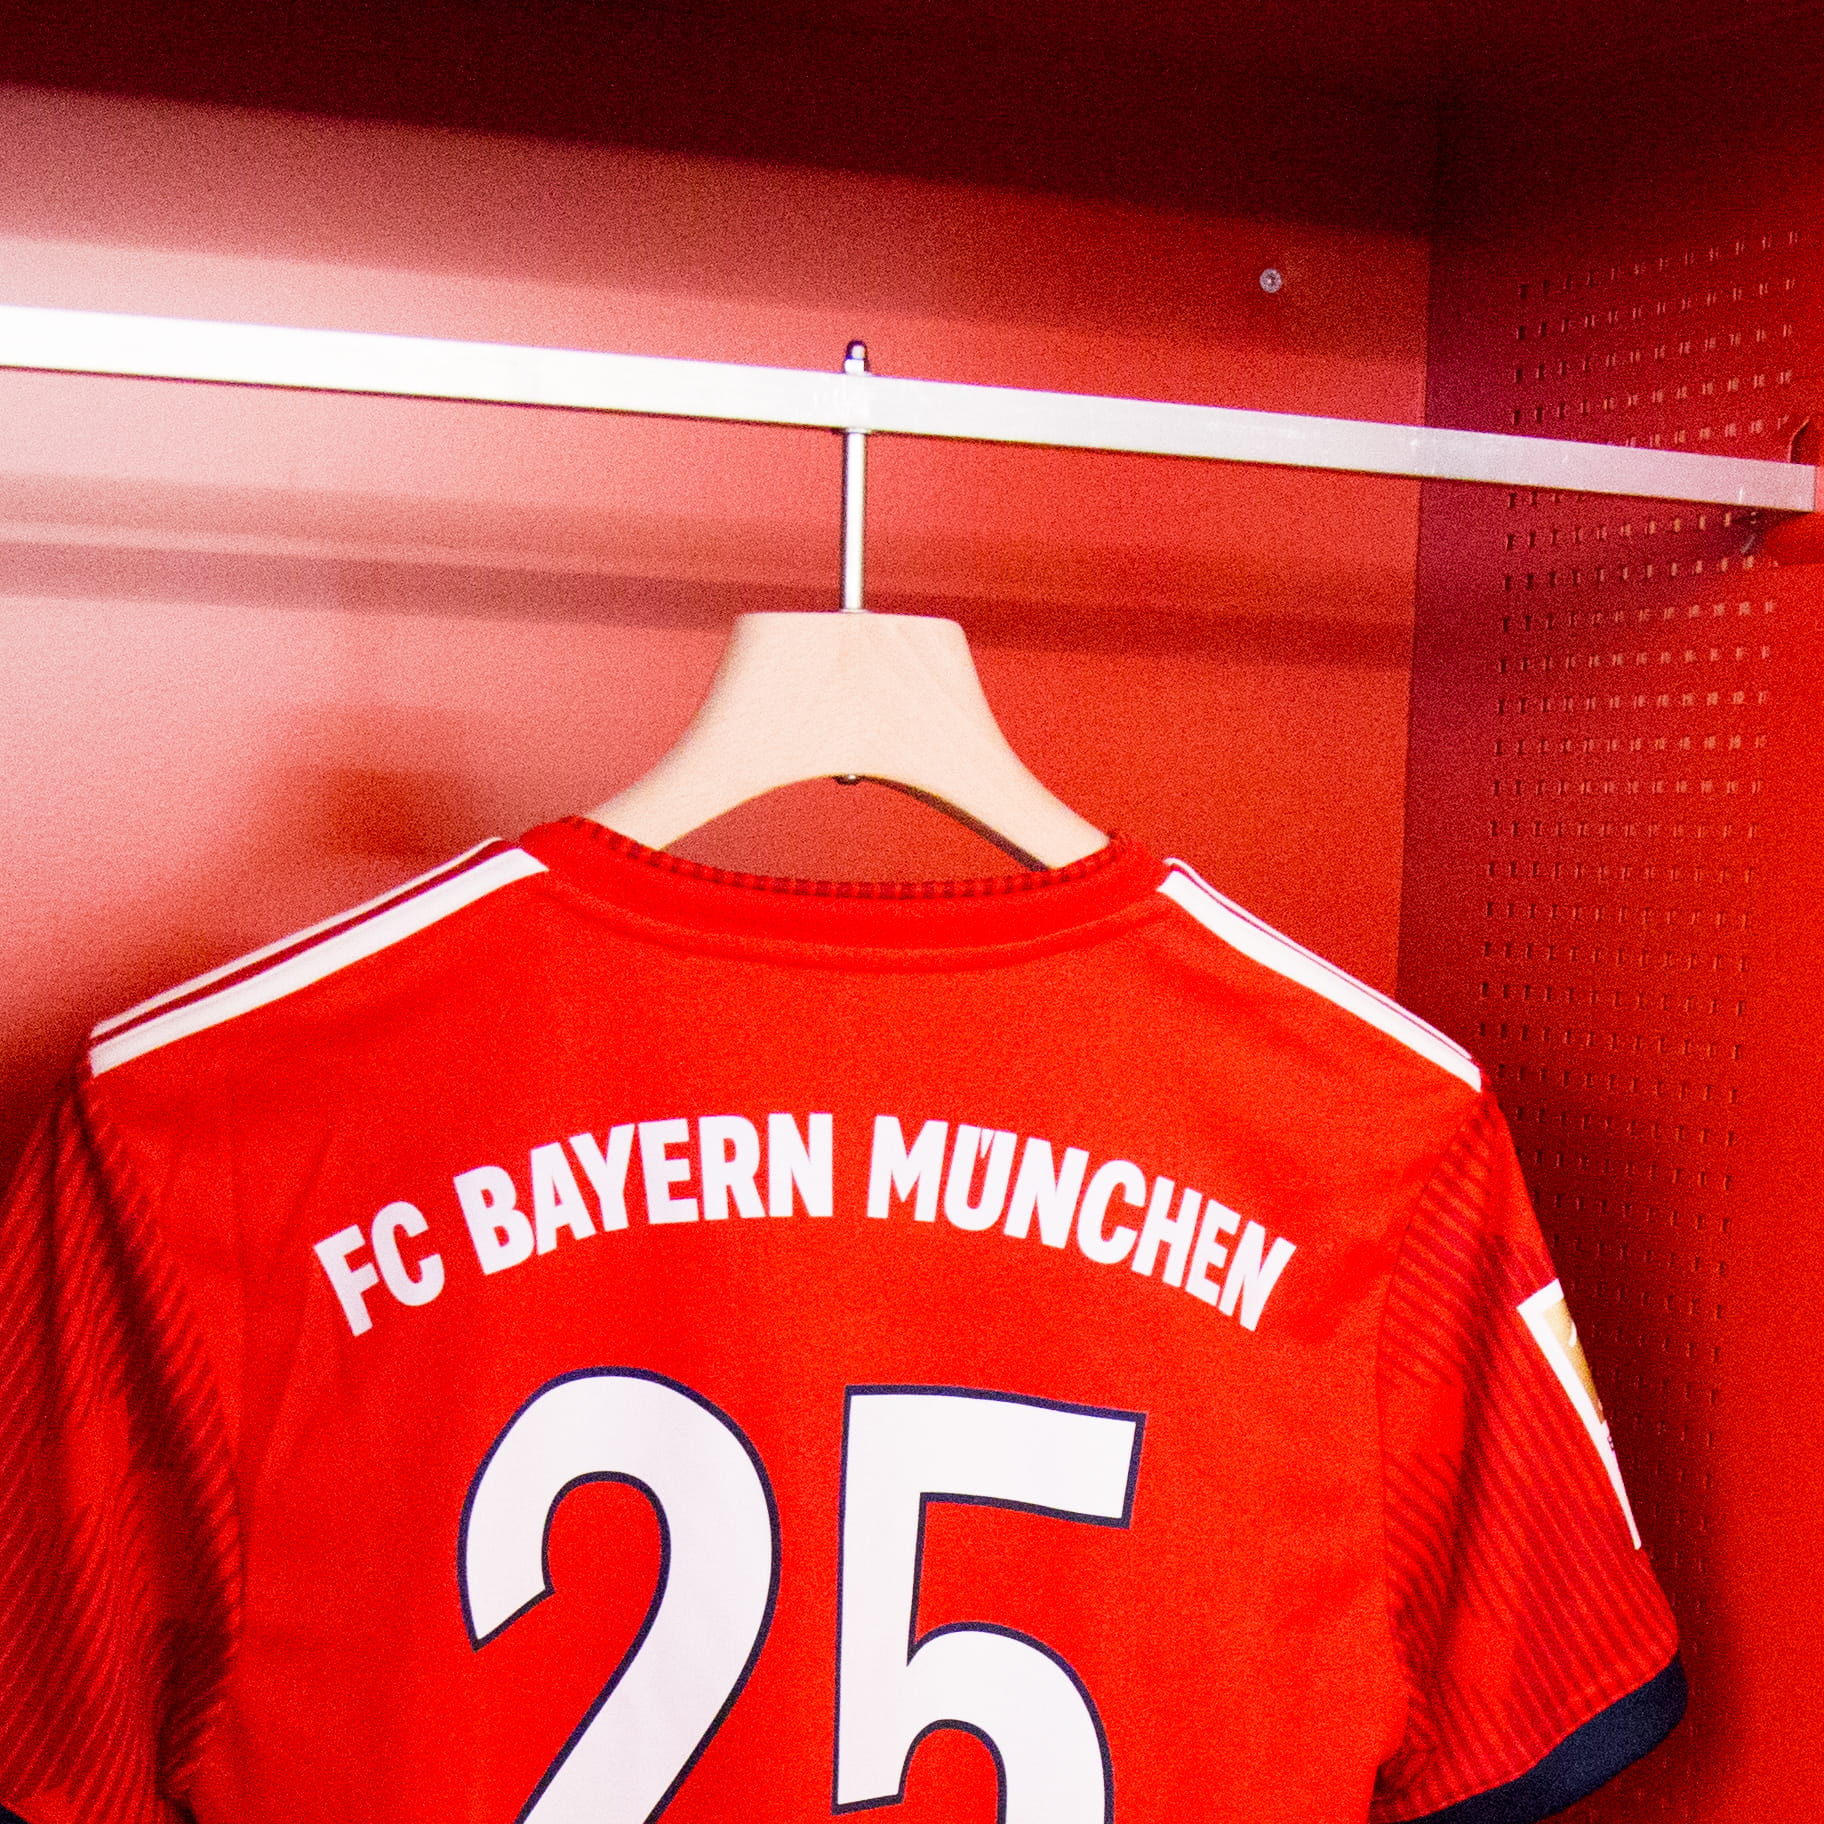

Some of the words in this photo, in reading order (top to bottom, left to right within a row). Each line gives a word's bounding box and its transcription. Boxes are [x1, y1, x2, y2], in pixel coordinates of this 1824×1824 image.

[313, 1201, 446, 1337] FC
[453, 1112, 834, 1276] BAYERN
[866, 1114, 1297, 1332] MÜNCHEN
